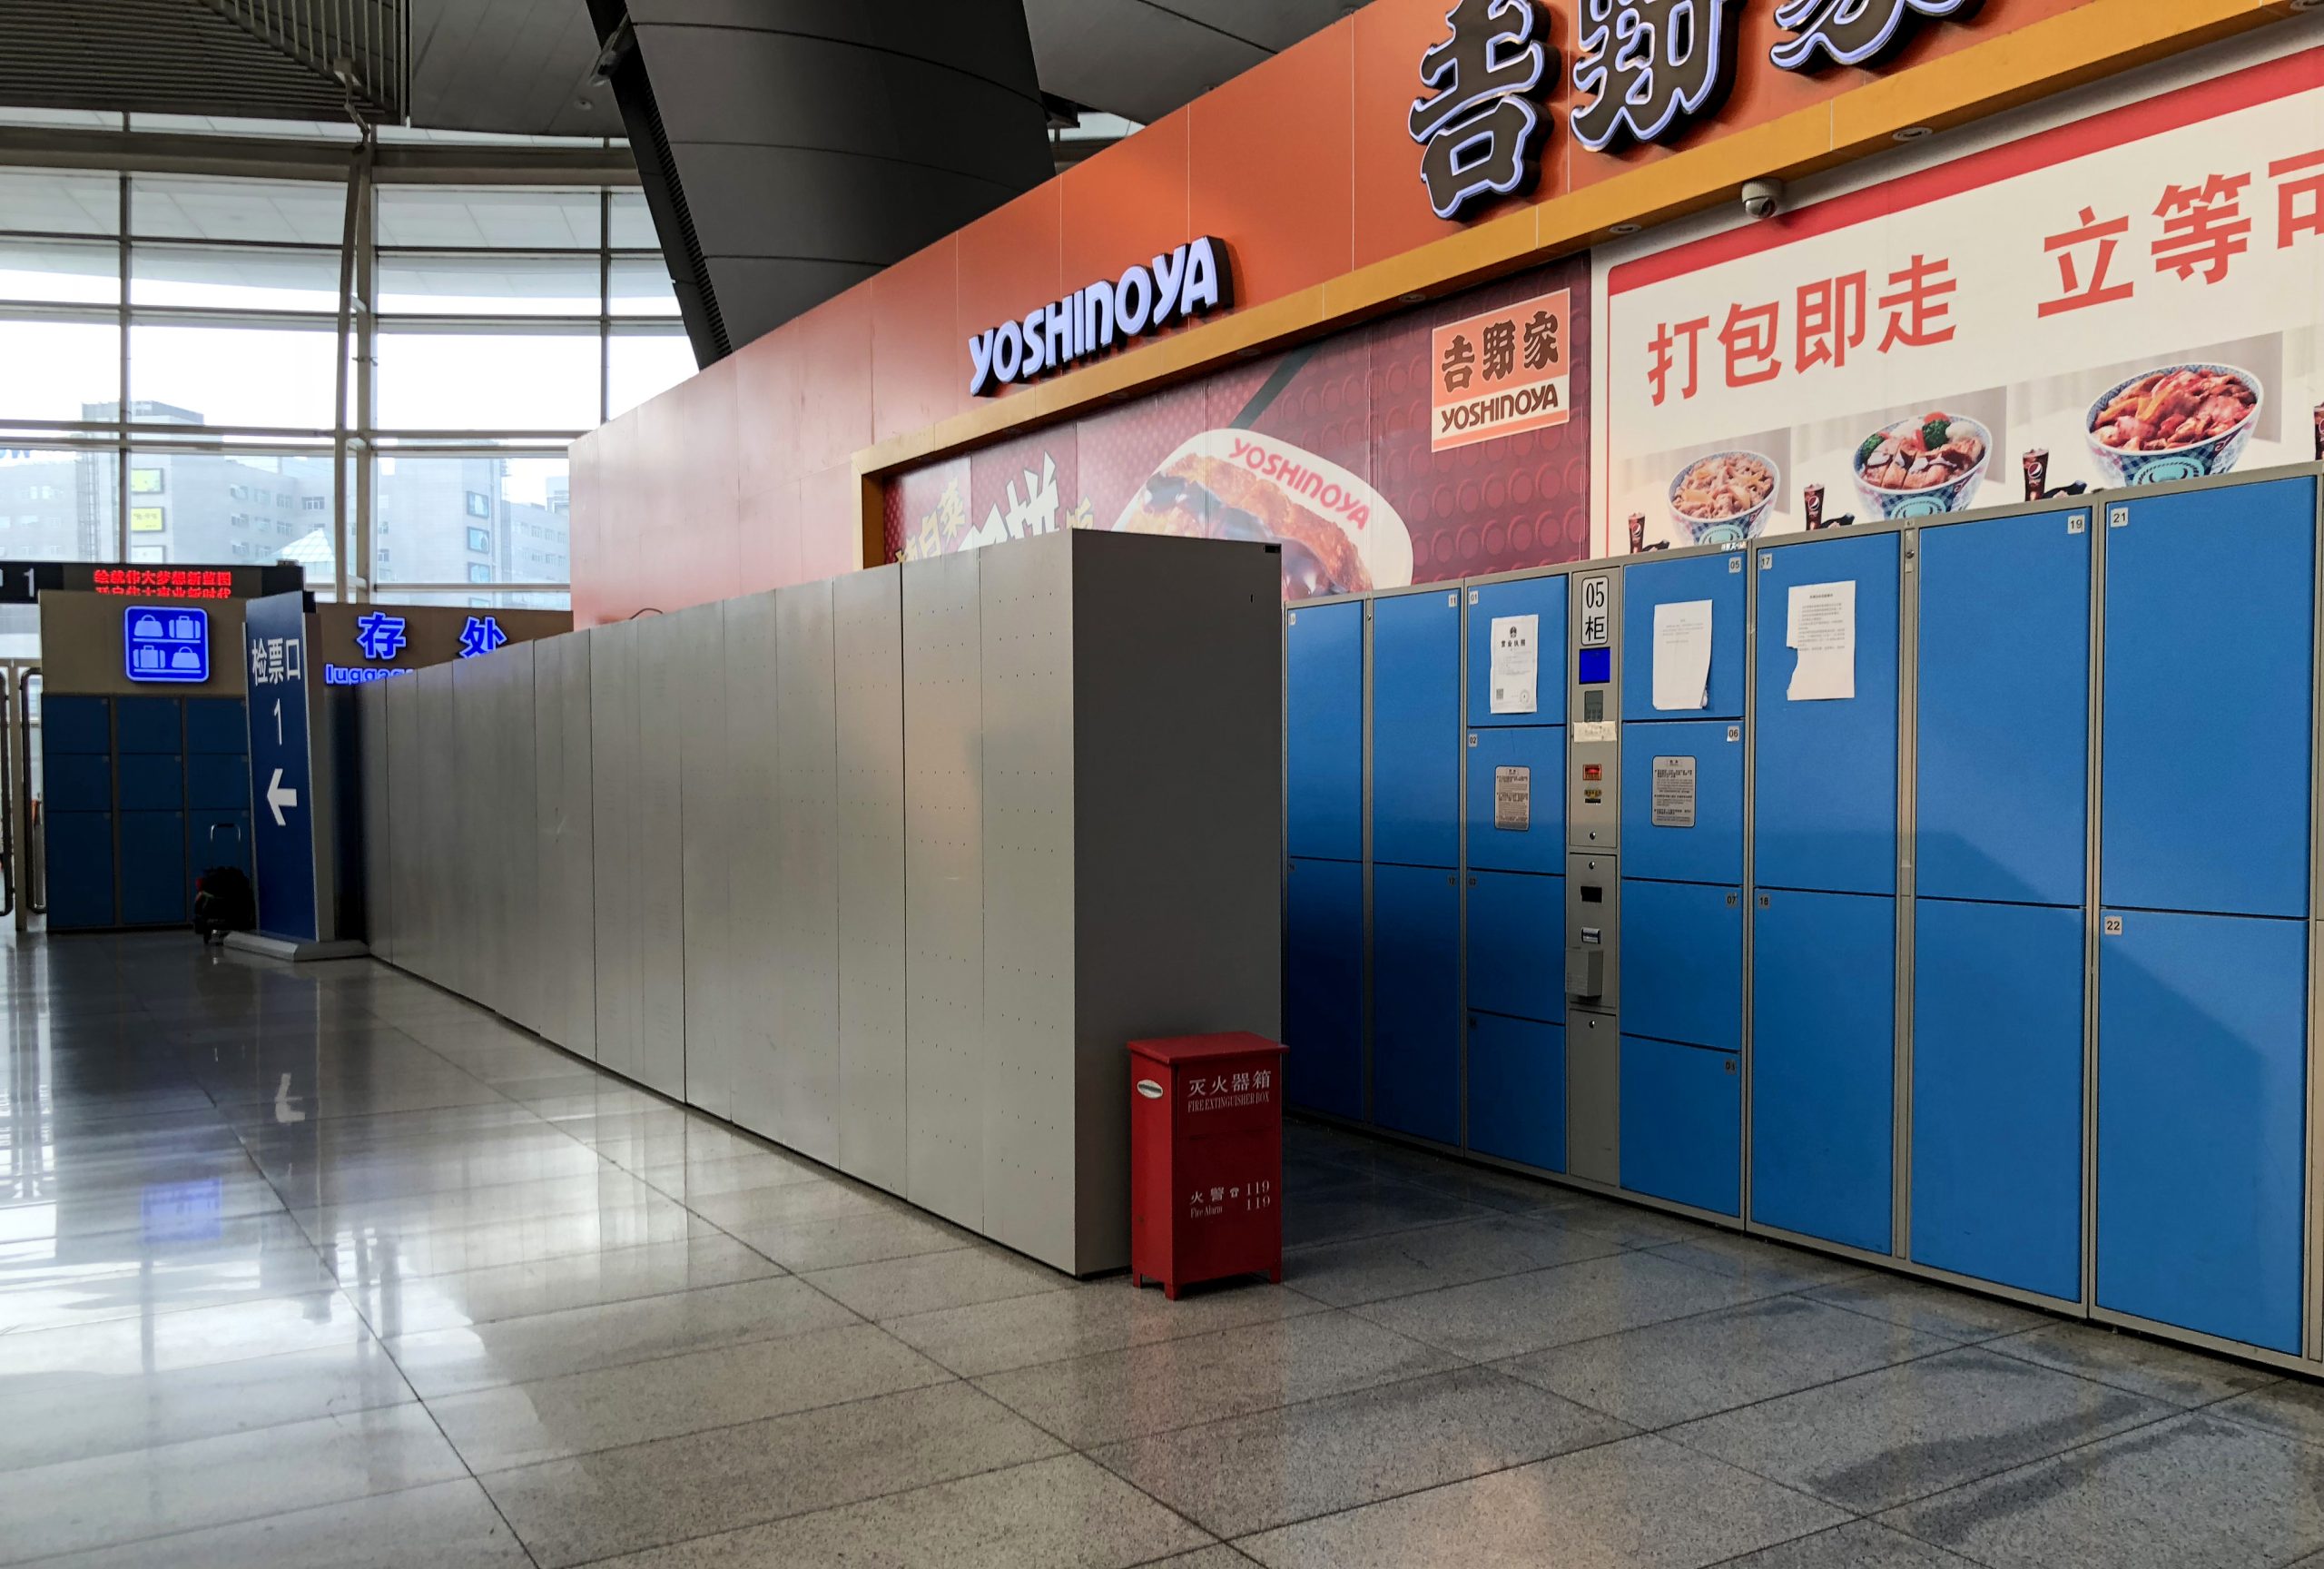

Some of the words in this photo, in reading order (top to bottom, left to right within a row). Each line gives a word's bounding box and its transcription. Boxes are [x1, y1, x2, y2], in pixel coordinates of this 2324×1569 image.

[968, 234, 1220, 397] YOSHINOYA
[1647, 254, 1957, 407] 打包即走
[1441, 311, 1559, 393] 吉野家
[1441, 383, 1559, 433] YOSHINOYA
[1228, 437, 1371, 530] YOSHINOYA
[2071, 519, 2083, 529] 19
[2113, 512, 2126, 523] 21
[1730, 560, 1739, 569] 05
[1761, 557, 1770, 565] 17
[24, 567, 34, 597] 1
[1586, 581, 1605, 609] 05
[1585, 616, 1605, 642] 柜
[251, 637, 301, 686] 检票口
[273, 697, 282, 745] 1
[1728, 729, 1738, 737] 06
[2106, 921, 2121, 931] 22
[1187, 1069, 1272, 1098] 灭火器箱
[1187, 1099, 1205, 1113] FIRE
[1205, 1092, 1256, 1111] EXTINGUISHER
[1256, 1090, 1270, 1105] BOX
[1189, 1187, 1225, 1205] 火警
[1246, 1179, 1270, 1197] 119
[1246, 1195, 1271, 1211] 119
[1190, 1207, 1204, 1219] Fire
[1205, 1204, 1223, 1217] Alarm
